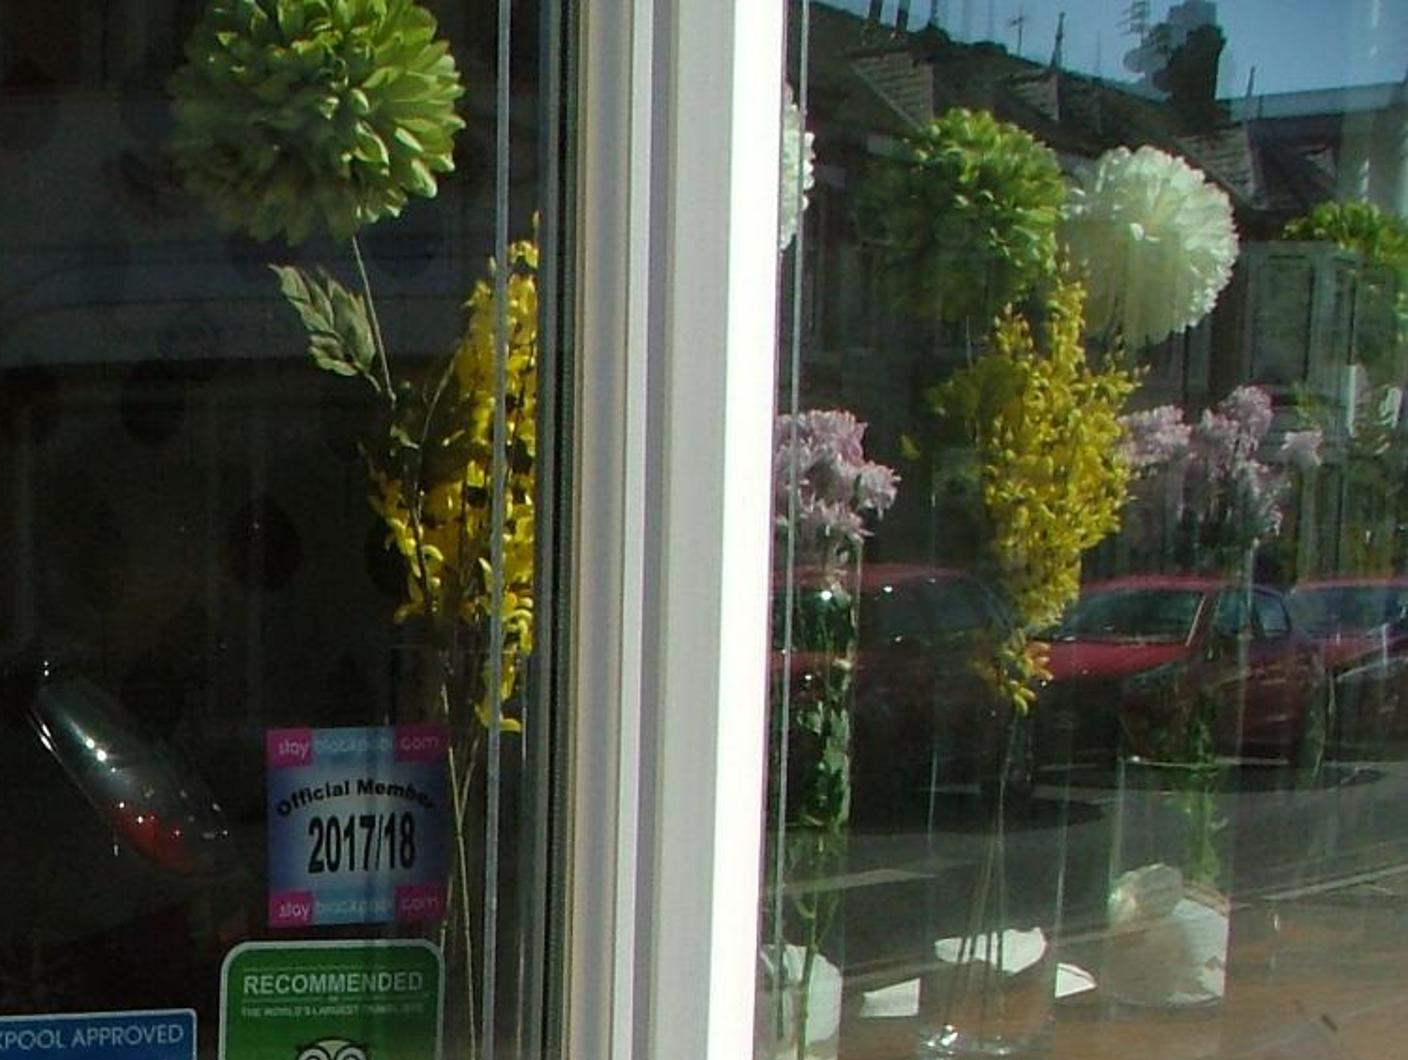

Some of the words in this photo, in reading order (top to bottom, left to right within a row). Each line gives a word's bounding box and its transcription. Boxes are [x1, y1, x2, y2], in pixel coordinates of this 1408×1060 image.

[277, 780, 350, 817] Official
[308, 811, 415, 874] 2017/18
[243, 971, 424, 995] RECOMMENDED
[71, 1023, 185, 1047] APPROVED
